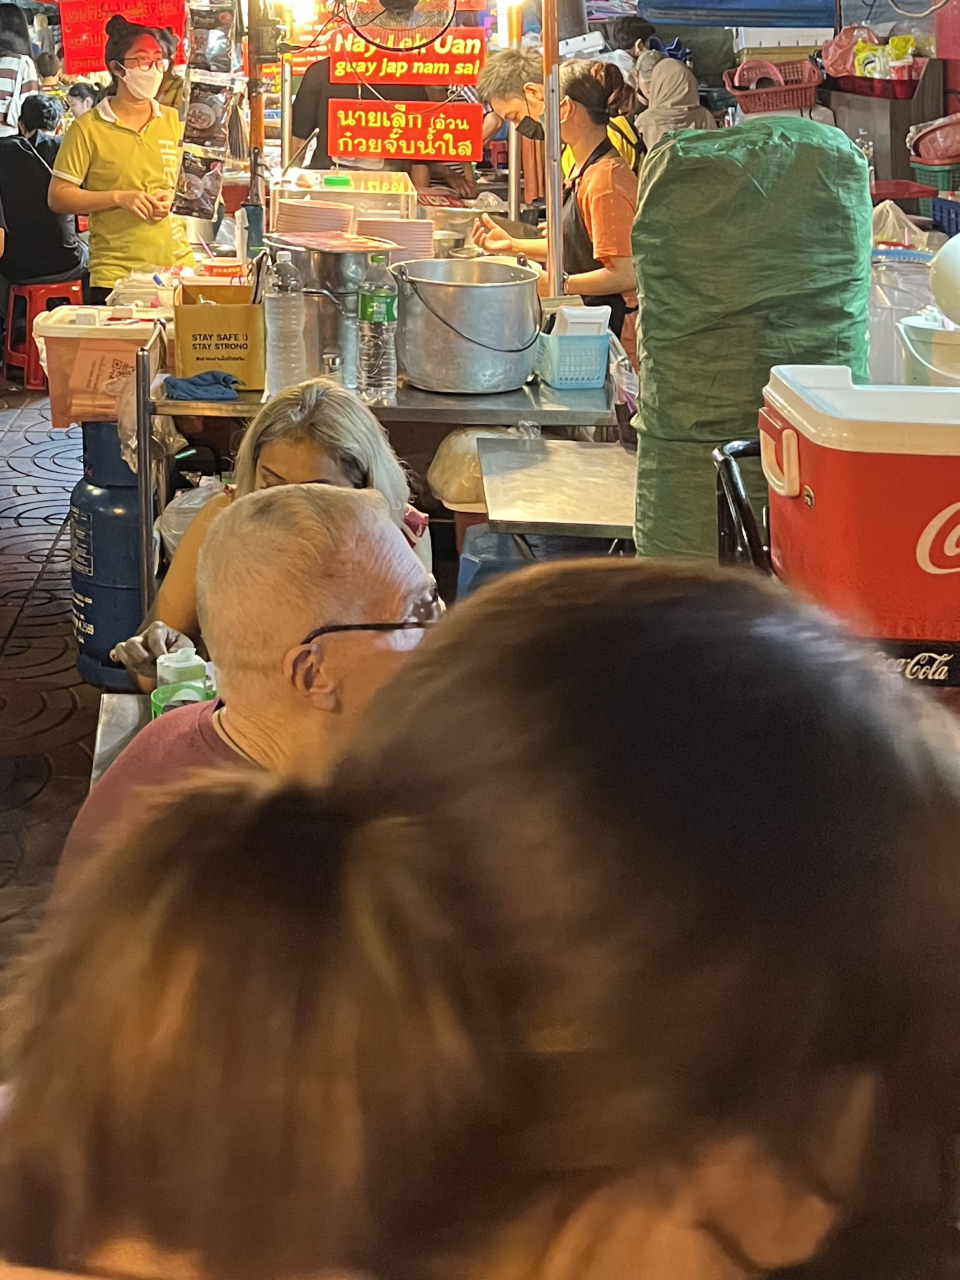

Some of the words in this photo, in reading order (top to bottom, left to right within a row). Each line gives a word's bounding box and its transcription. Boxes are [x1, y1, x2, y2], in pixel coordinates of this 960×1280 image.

[434, 35, 481, 54] Uan
[334, 61, 377, 77] guay
[379, 58, 408, 77] jap
[412, 61, 449, 75] nam
[192, 333, 213, 341] STAY
[216, 333, 239, 341] SAFE
